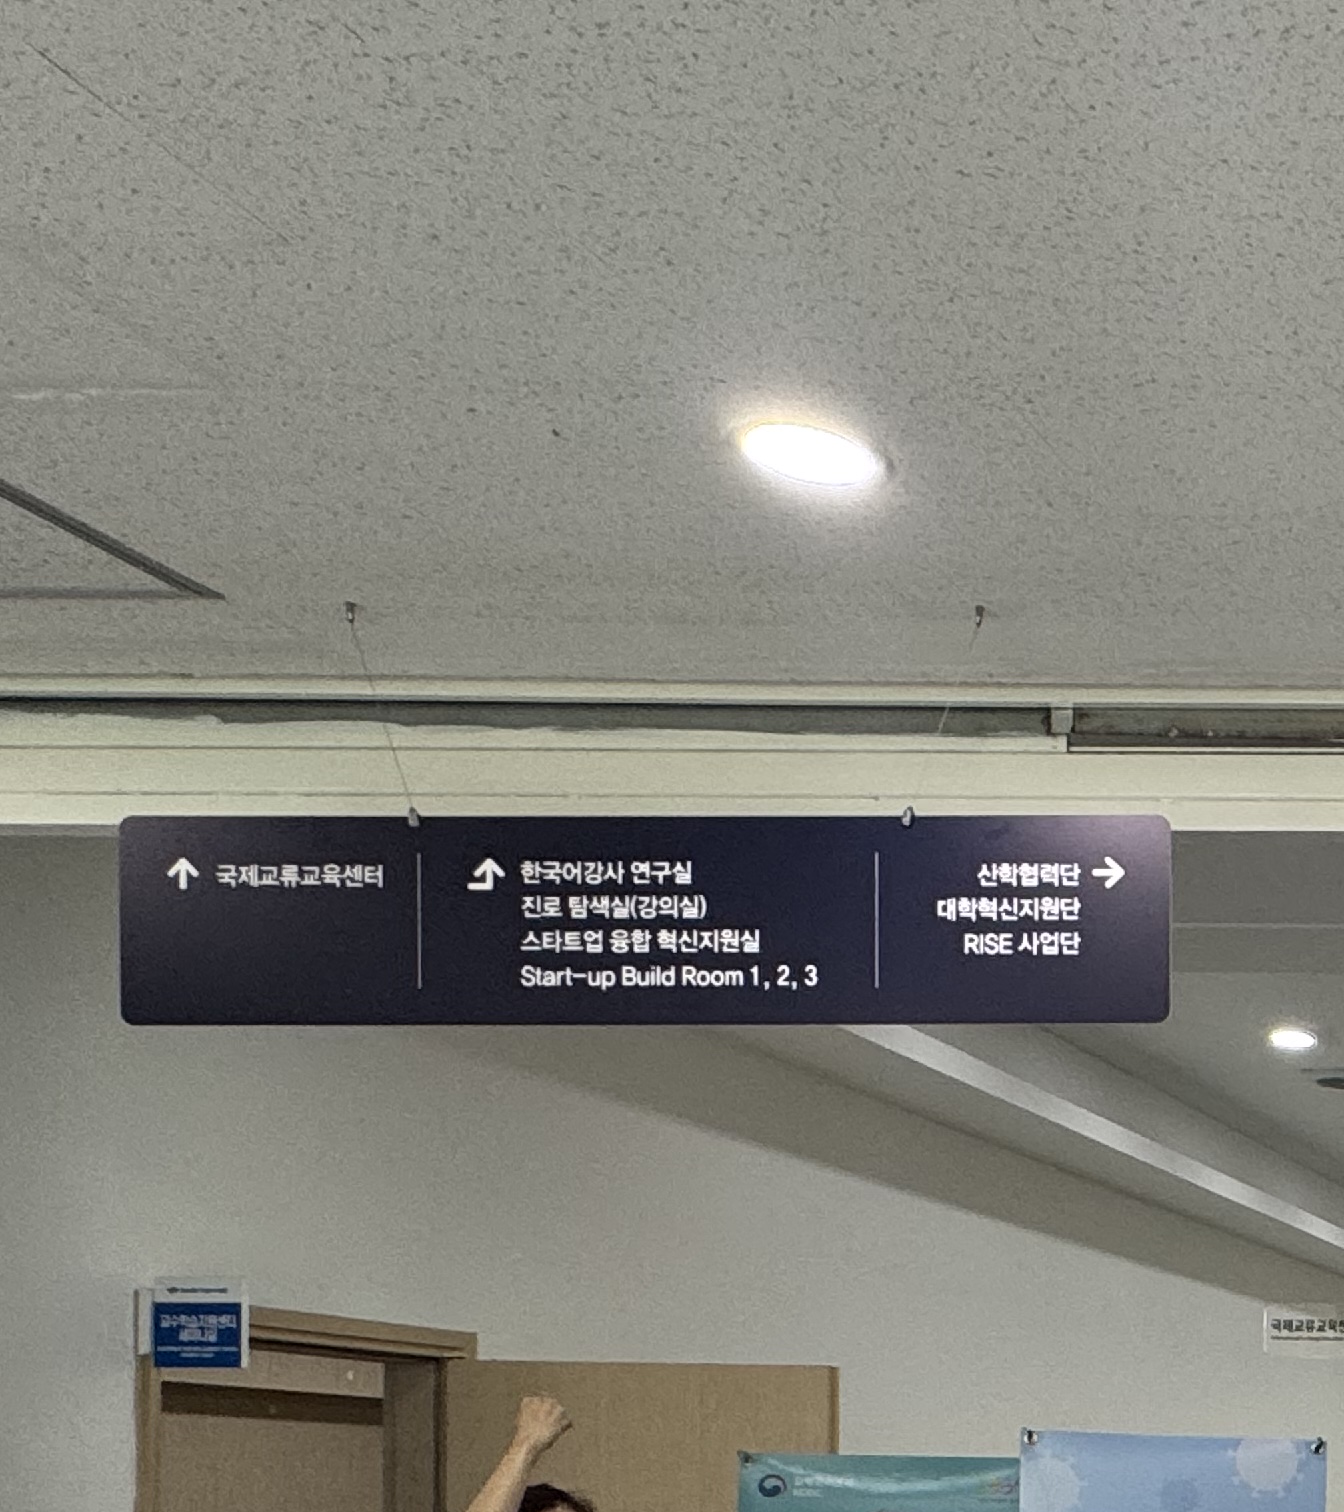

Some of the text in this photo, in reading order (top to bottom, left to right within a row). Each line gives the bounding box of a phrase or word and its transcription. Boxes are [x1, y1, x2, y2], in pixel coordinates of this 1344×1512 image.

[216, 862, 384, 889] 국제교류교육센터
[520, 860, 692, 886] 한국어강사 연구실
[976, 861, 1081, 887] 산학협력단
[520, 893, 707, 921] 진로 탐색실(강의실)
[936, 896, 1081, 922] 대학혁신지원단
[520, 929, 760, 955] 스타트업 융합 혁신지원실
[962, 931, 1081, 956] RISE 사업단
[520, 963, 818, 992] Start-up Build Room 1, 2, 3
